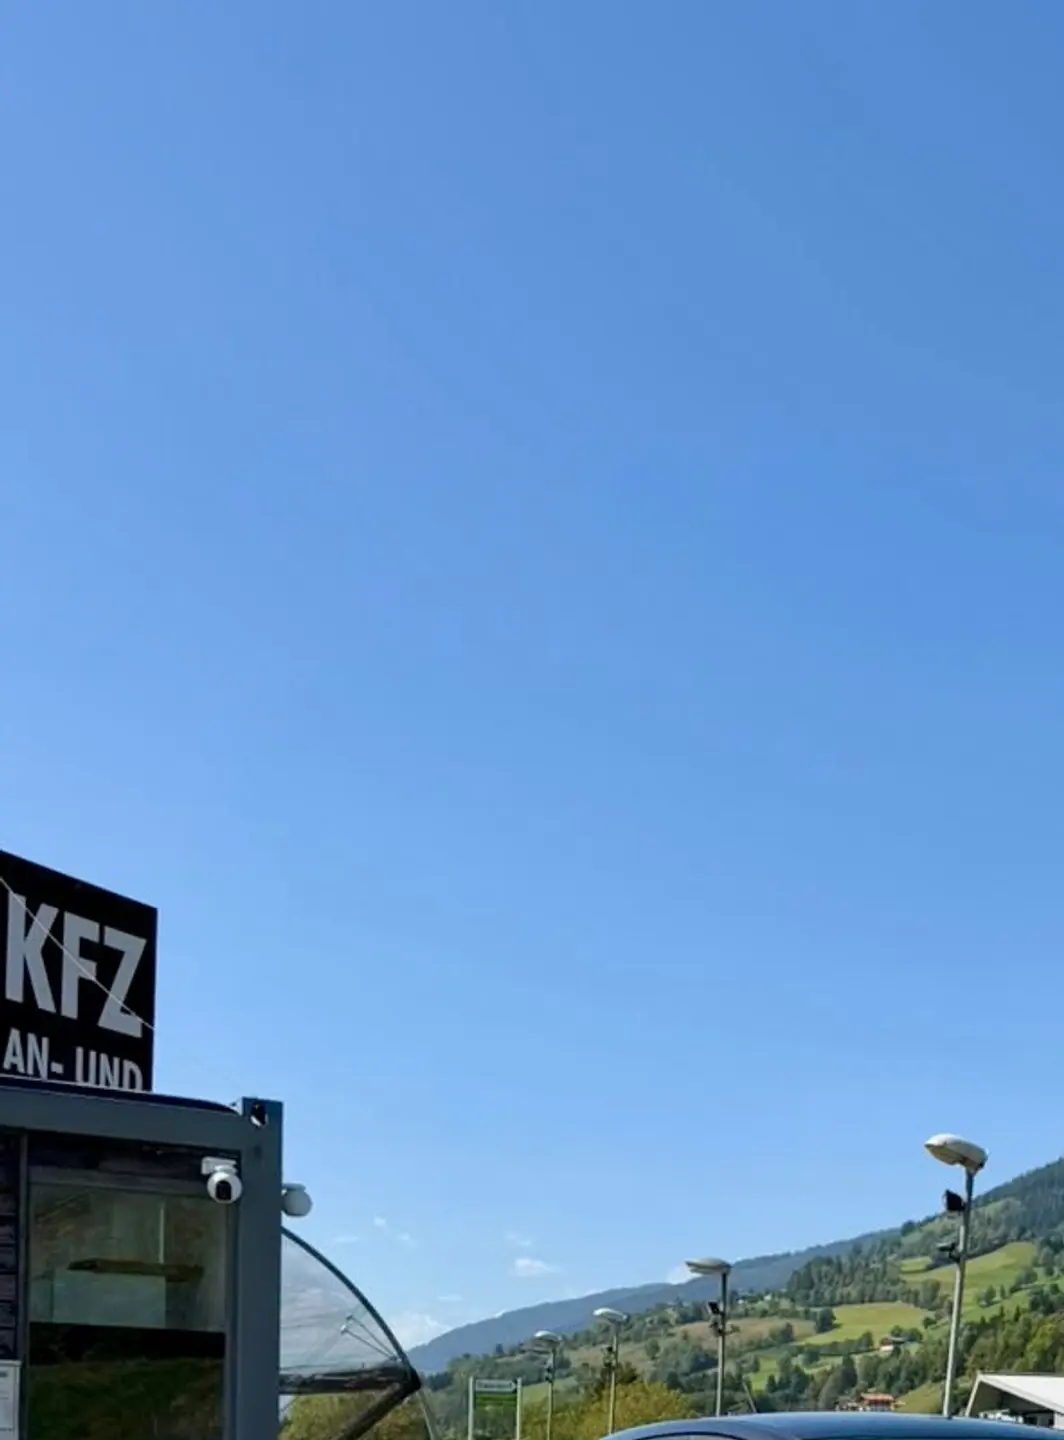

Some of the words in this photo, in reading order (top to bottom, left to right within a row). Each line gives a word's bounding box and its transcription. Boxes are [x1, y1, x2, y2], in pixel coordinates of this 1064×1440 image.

[5, 892, 147, 1038] KFZ
[3, 1027, 64, 1080] AN-
[75, 1046, 144, 1091] UND
